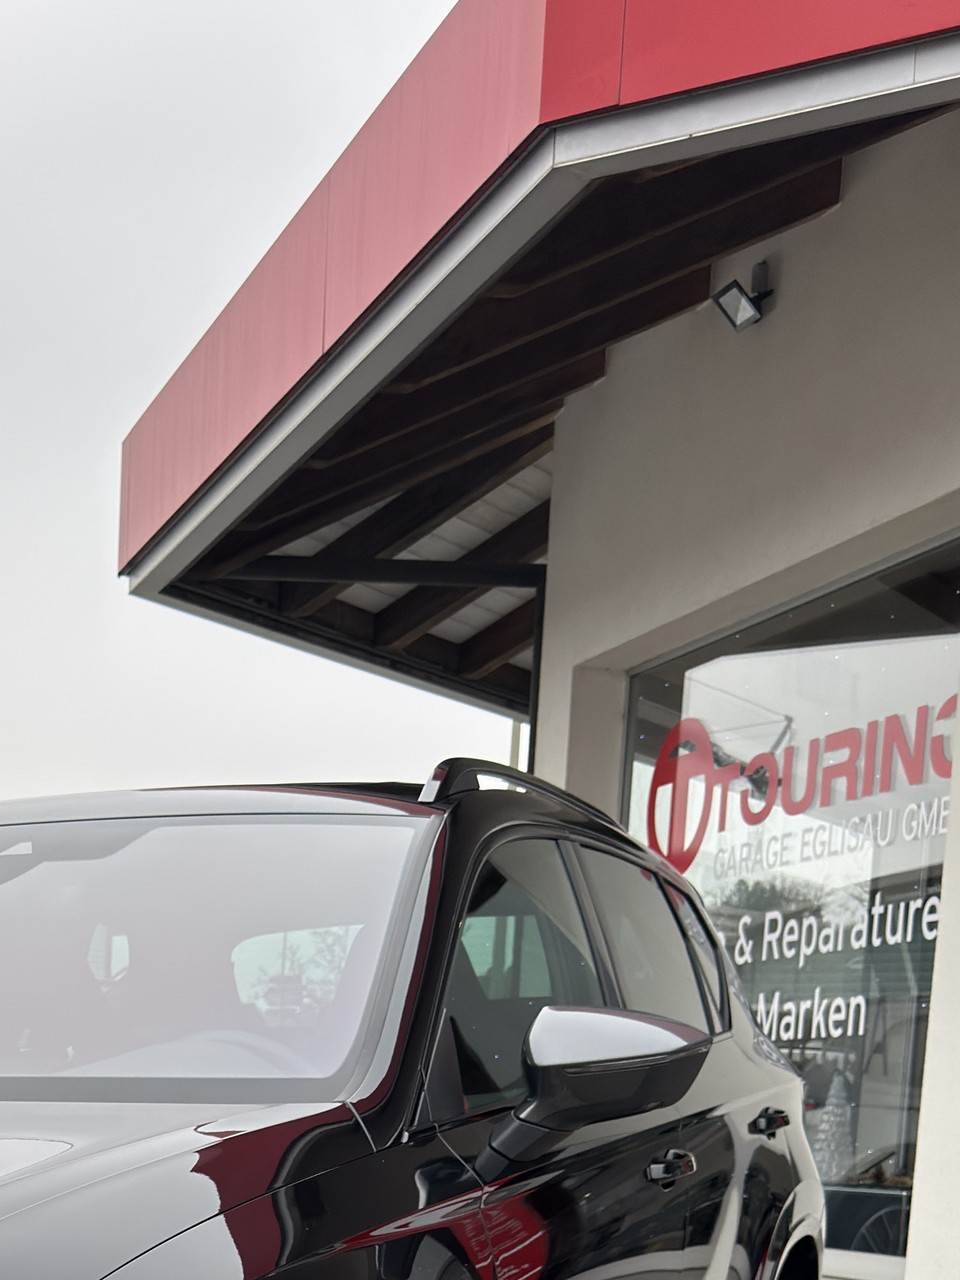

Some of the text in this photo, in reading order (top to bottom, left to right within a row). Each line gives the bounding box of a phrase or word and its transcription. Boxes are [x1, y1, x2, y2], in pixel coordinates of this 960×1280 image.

[713, 831, 793, 880] GARAGE
[799, 808, 893, 864] EGLISAU
[734, 913, 754, 966] &
[756, 985, 867, 1042] Marken
